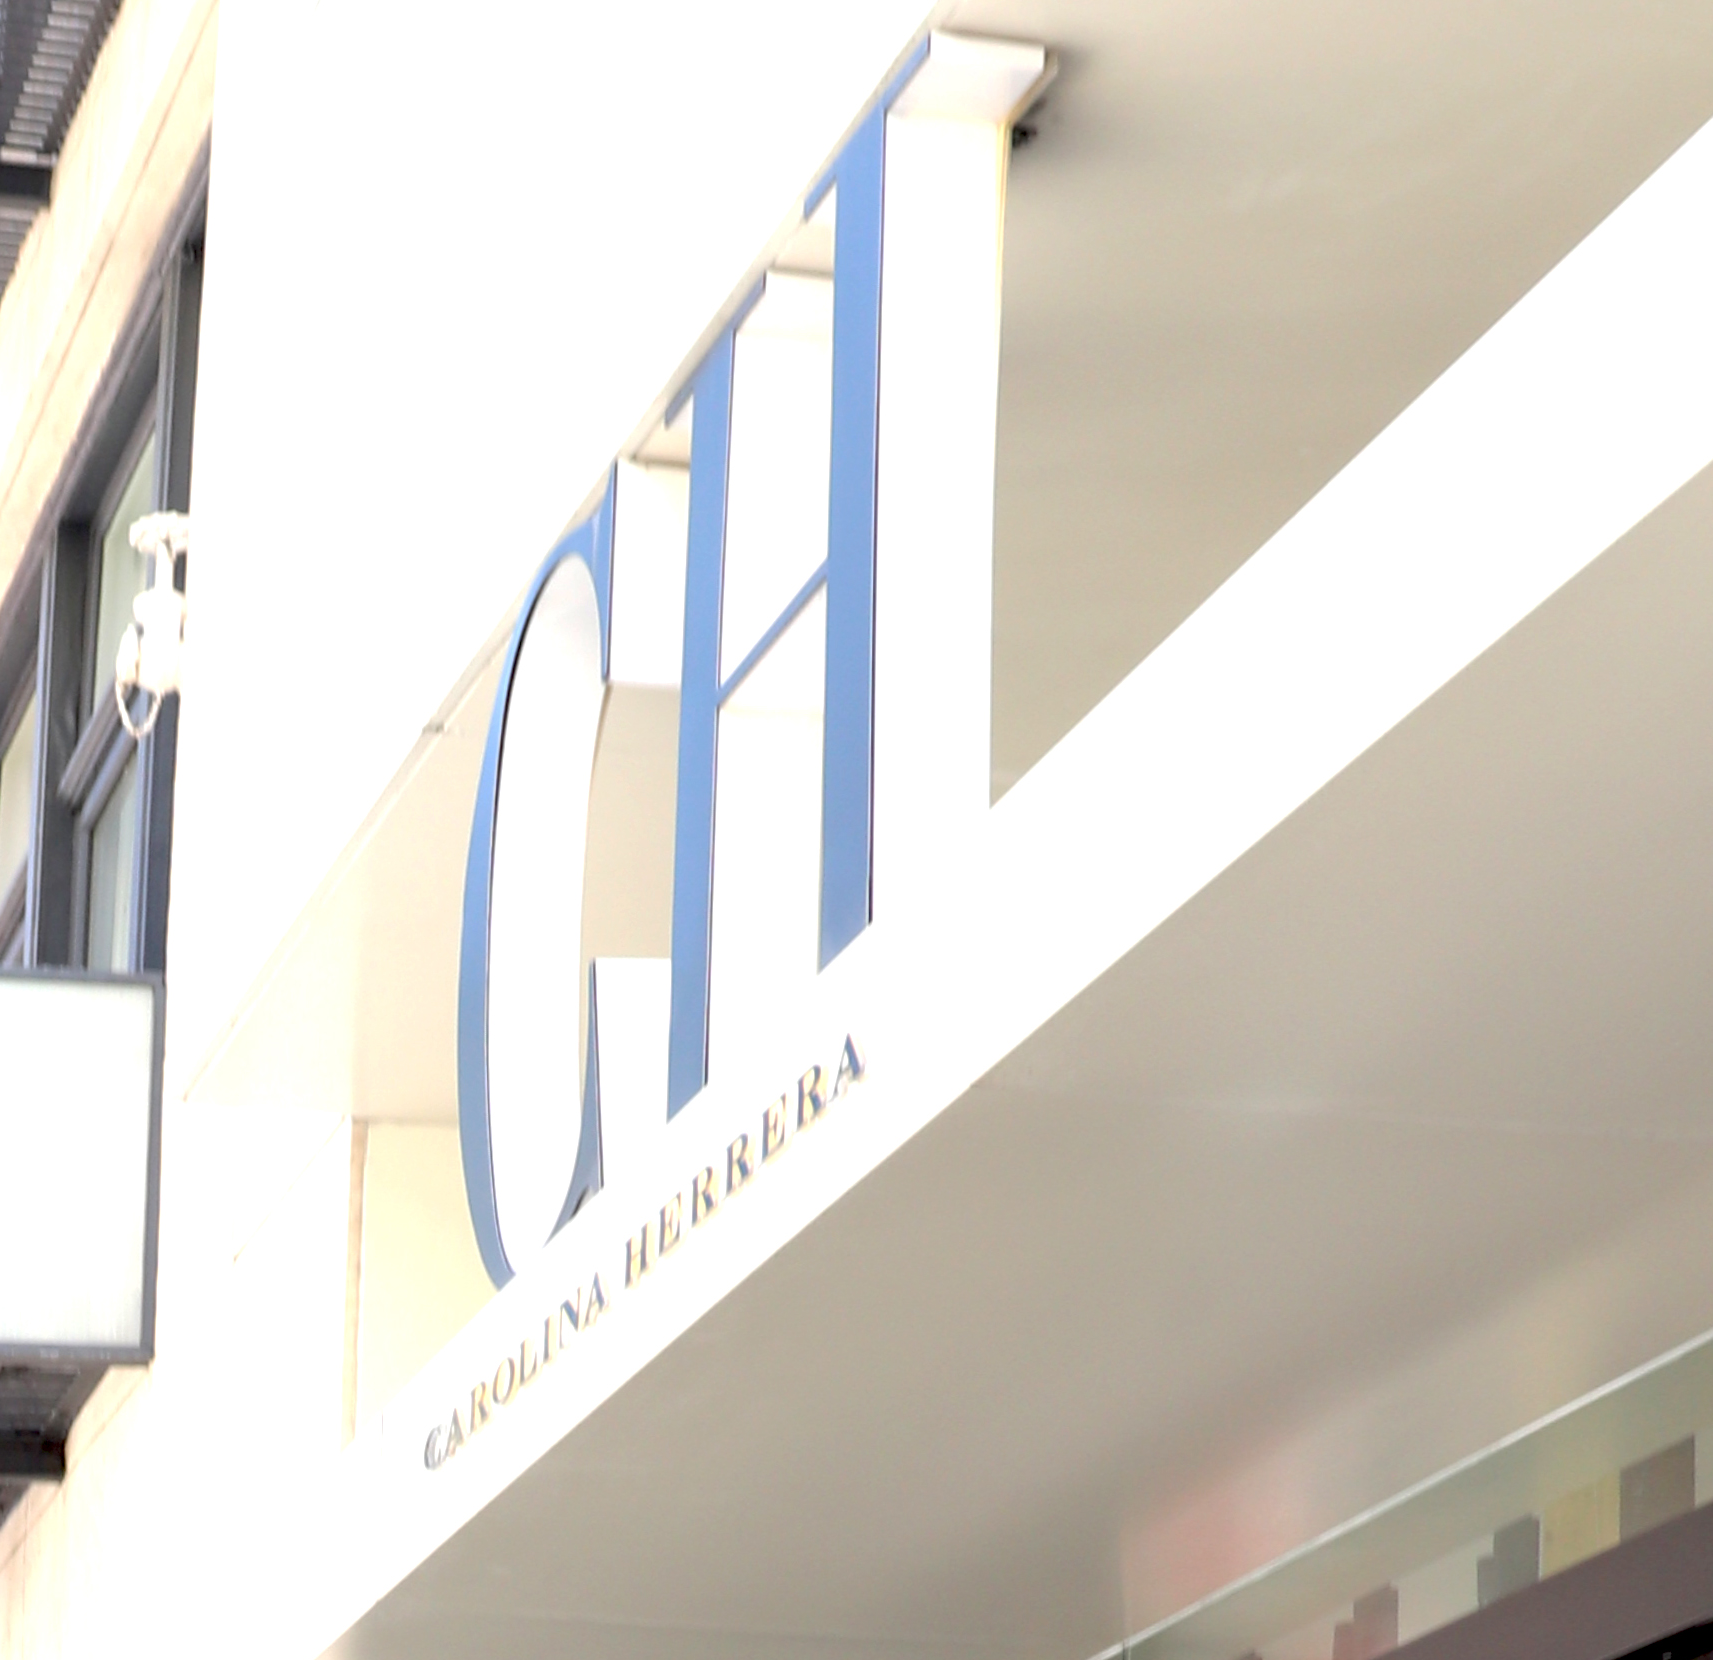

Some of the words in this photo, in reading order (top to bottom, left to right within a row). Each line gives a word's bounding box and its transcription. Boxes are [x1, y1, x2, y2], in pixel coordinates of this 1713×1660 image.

[456, 33, 931, 1292] CH
[423, 1271, 610, 1471] CAROLINA
[624, 1032, 867, 1290] HERRERA
